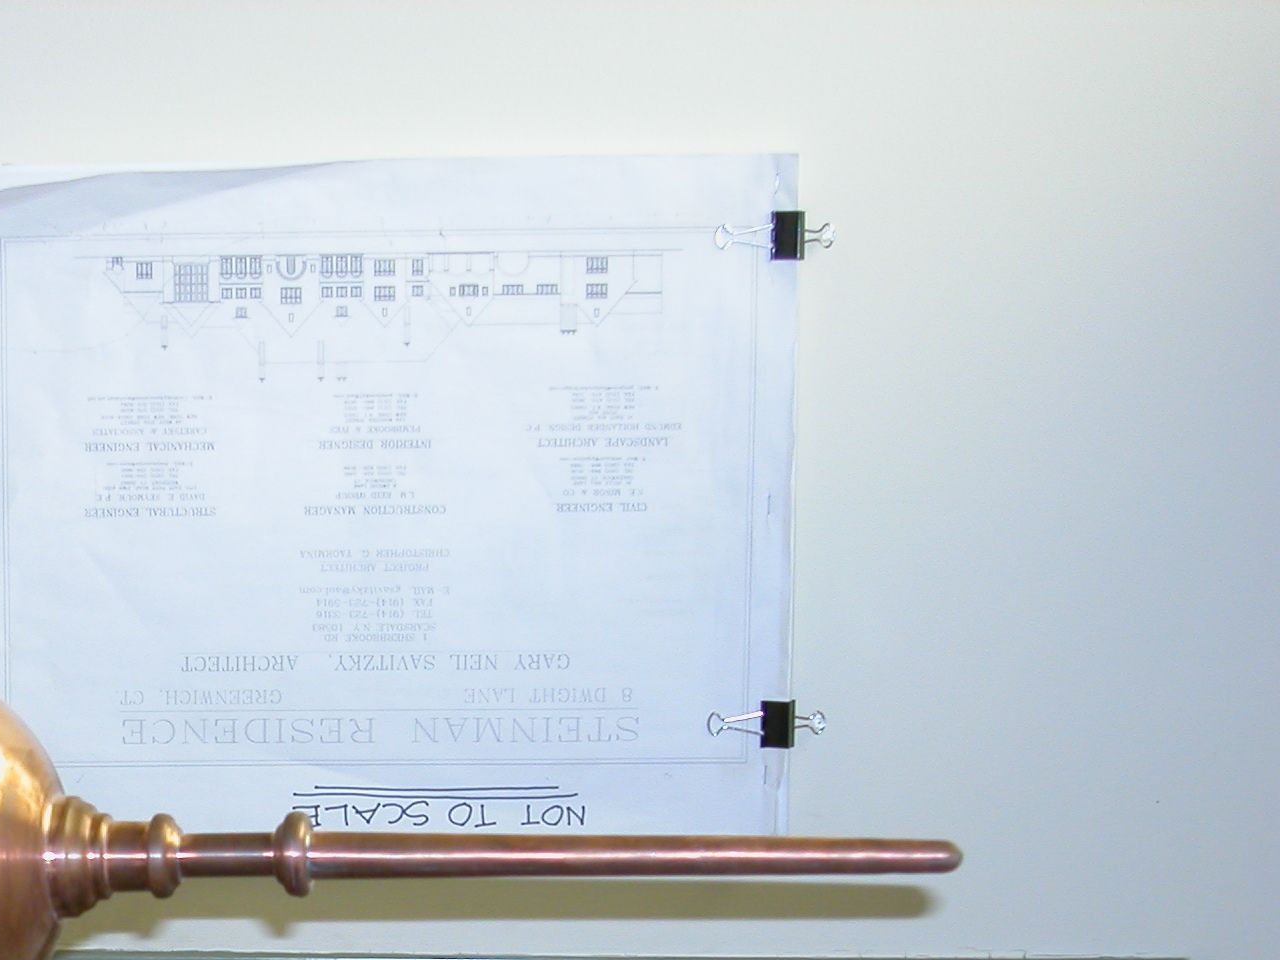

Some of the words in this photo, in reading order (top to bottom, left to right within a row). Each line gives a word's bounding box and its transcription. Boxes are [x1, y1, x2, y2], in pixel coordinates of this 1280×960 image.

[84, 442, 139, 452] ENGINEER
[146, 442, 215, 452] MECHANICAL
[319, 440, 373, 449] DESIGNER
[380, 439, 431, 449] INTERIOR
[537, 438, 597, 447] ARCHITECT
[604, 437, 668, 447] LANDSCAPE
[84, 508, 139, 517] ENGINEER
[146, 507, 216, 517] STRUCTURAL
[304, 506, 356, 515] MANAGER
[363, 504, 446, 515] CONSTRUCTION
[554, 503, 613, 512] ENGINEER
[619, 503, 648, 512] CIVIL
[375, 548, 451, 558] CHRISTOPHER
[319, 562, 377, 573] ARCHITECT
[383, 562, 430, 572] PROJECT
[379, 623, 436, 631] SCARSDALE
[177, 654, 299, 672] ARCHITECT
[449, 653, 498, 671] NEIL
[513, 653, 570, 671] GARY
[464, 688, 515, 703] LANE
[529, 687, 606, 703] DWIGHT
[621, 688, 633, 702] 8
[121, 717, 375, 745] RESIDENCE
[411, 715, 641, 744] STEINMAN
[292, 800, 429, 827] SCALE
[448, 803, 496, 827] TO
[521, 804, 586, 827] NOT
